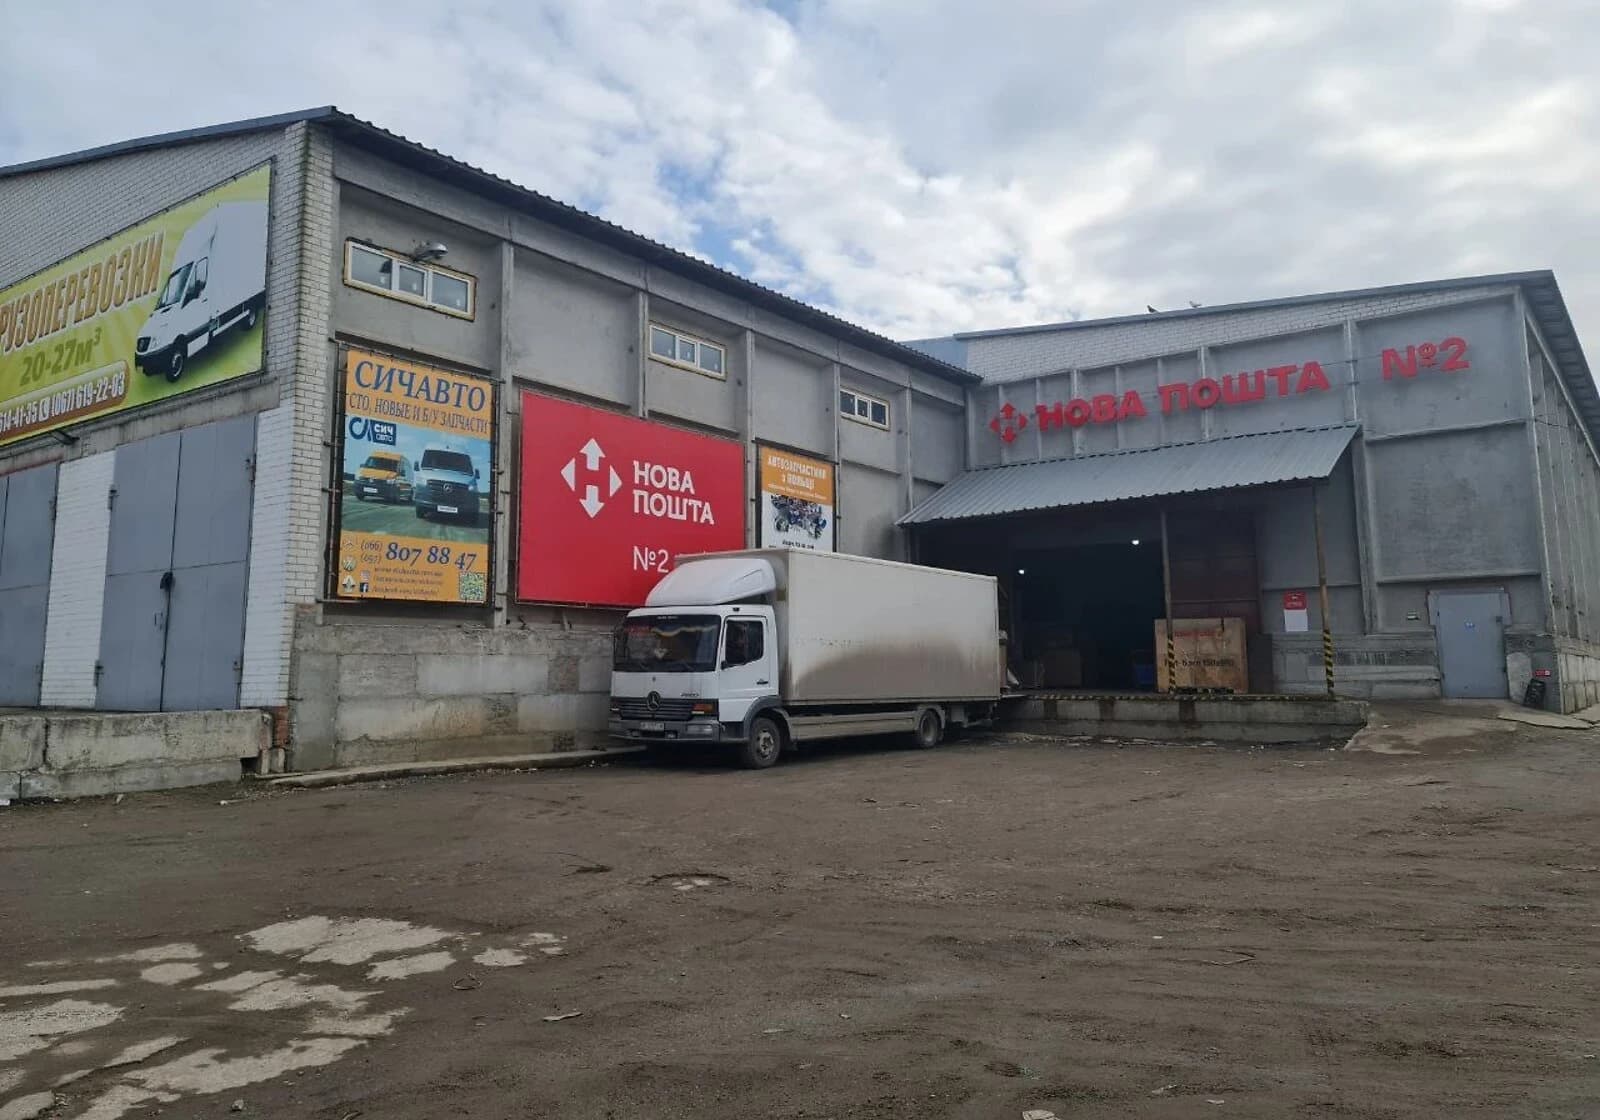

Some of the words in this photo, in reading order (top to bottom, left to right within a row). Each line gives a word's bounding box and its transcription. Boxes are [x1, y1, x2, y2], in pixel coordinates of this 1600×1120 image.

[355, 360, 486, 412] СИЧАВТО
[1035, 389, 1147, 433] НОВА
[1157, 360, 1330, 416] ПОШТА
[1381, 336, 1470, 381] №2
[374, 398, 411, 420] НОВЫЕ
[413, 406, 420, 422] И
[422, 406, 440, 427] Б/У
[632, 460, 695, 495] НОВА
[632, 489, 715, 525] ПОШТА
[386, 542, 422, 567] 807
[426, 545, 450, 565] 88
[455, 552, 477, 571] 47
[633, 545, 669, 574] №2
